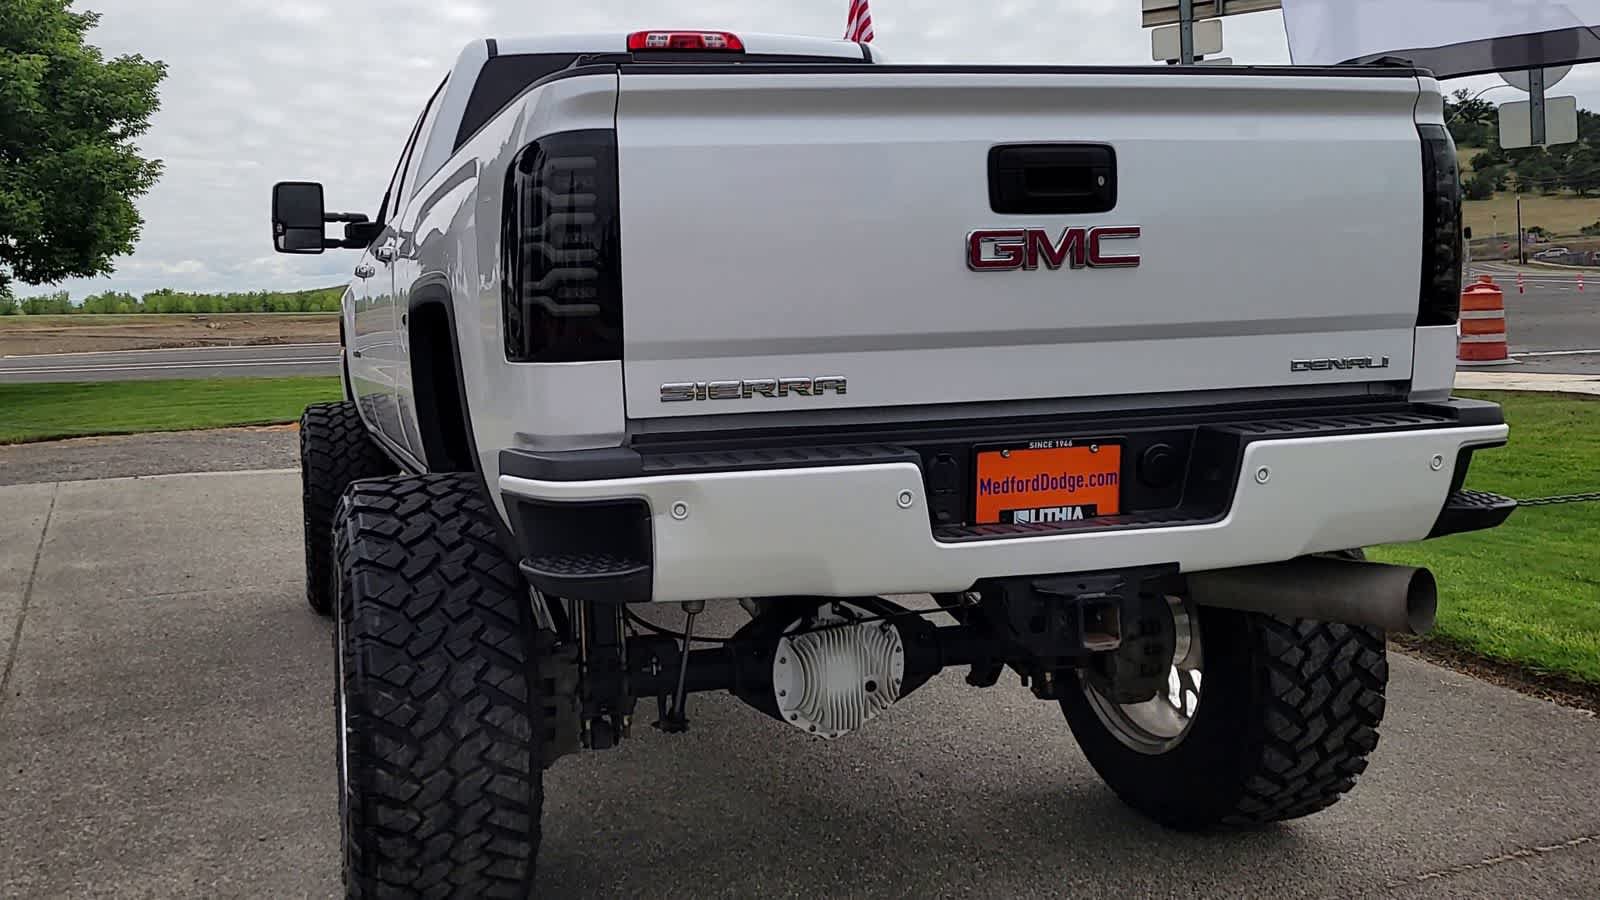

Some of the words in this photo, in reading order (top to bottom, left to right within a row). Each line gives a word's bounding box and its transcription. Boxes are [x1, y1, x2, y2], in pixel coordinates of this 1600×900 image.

[967, 226, 1140, 271] GMC
[1291, 356, 1389, 372] DENALI
[660, 375, 847, 402] SIERRA
[1029, 441, 1053, 449] SINCE
[979, 471, 1118, 496] MedfordDodge.com
[1030, 506, 1084, 523] LITHIA
